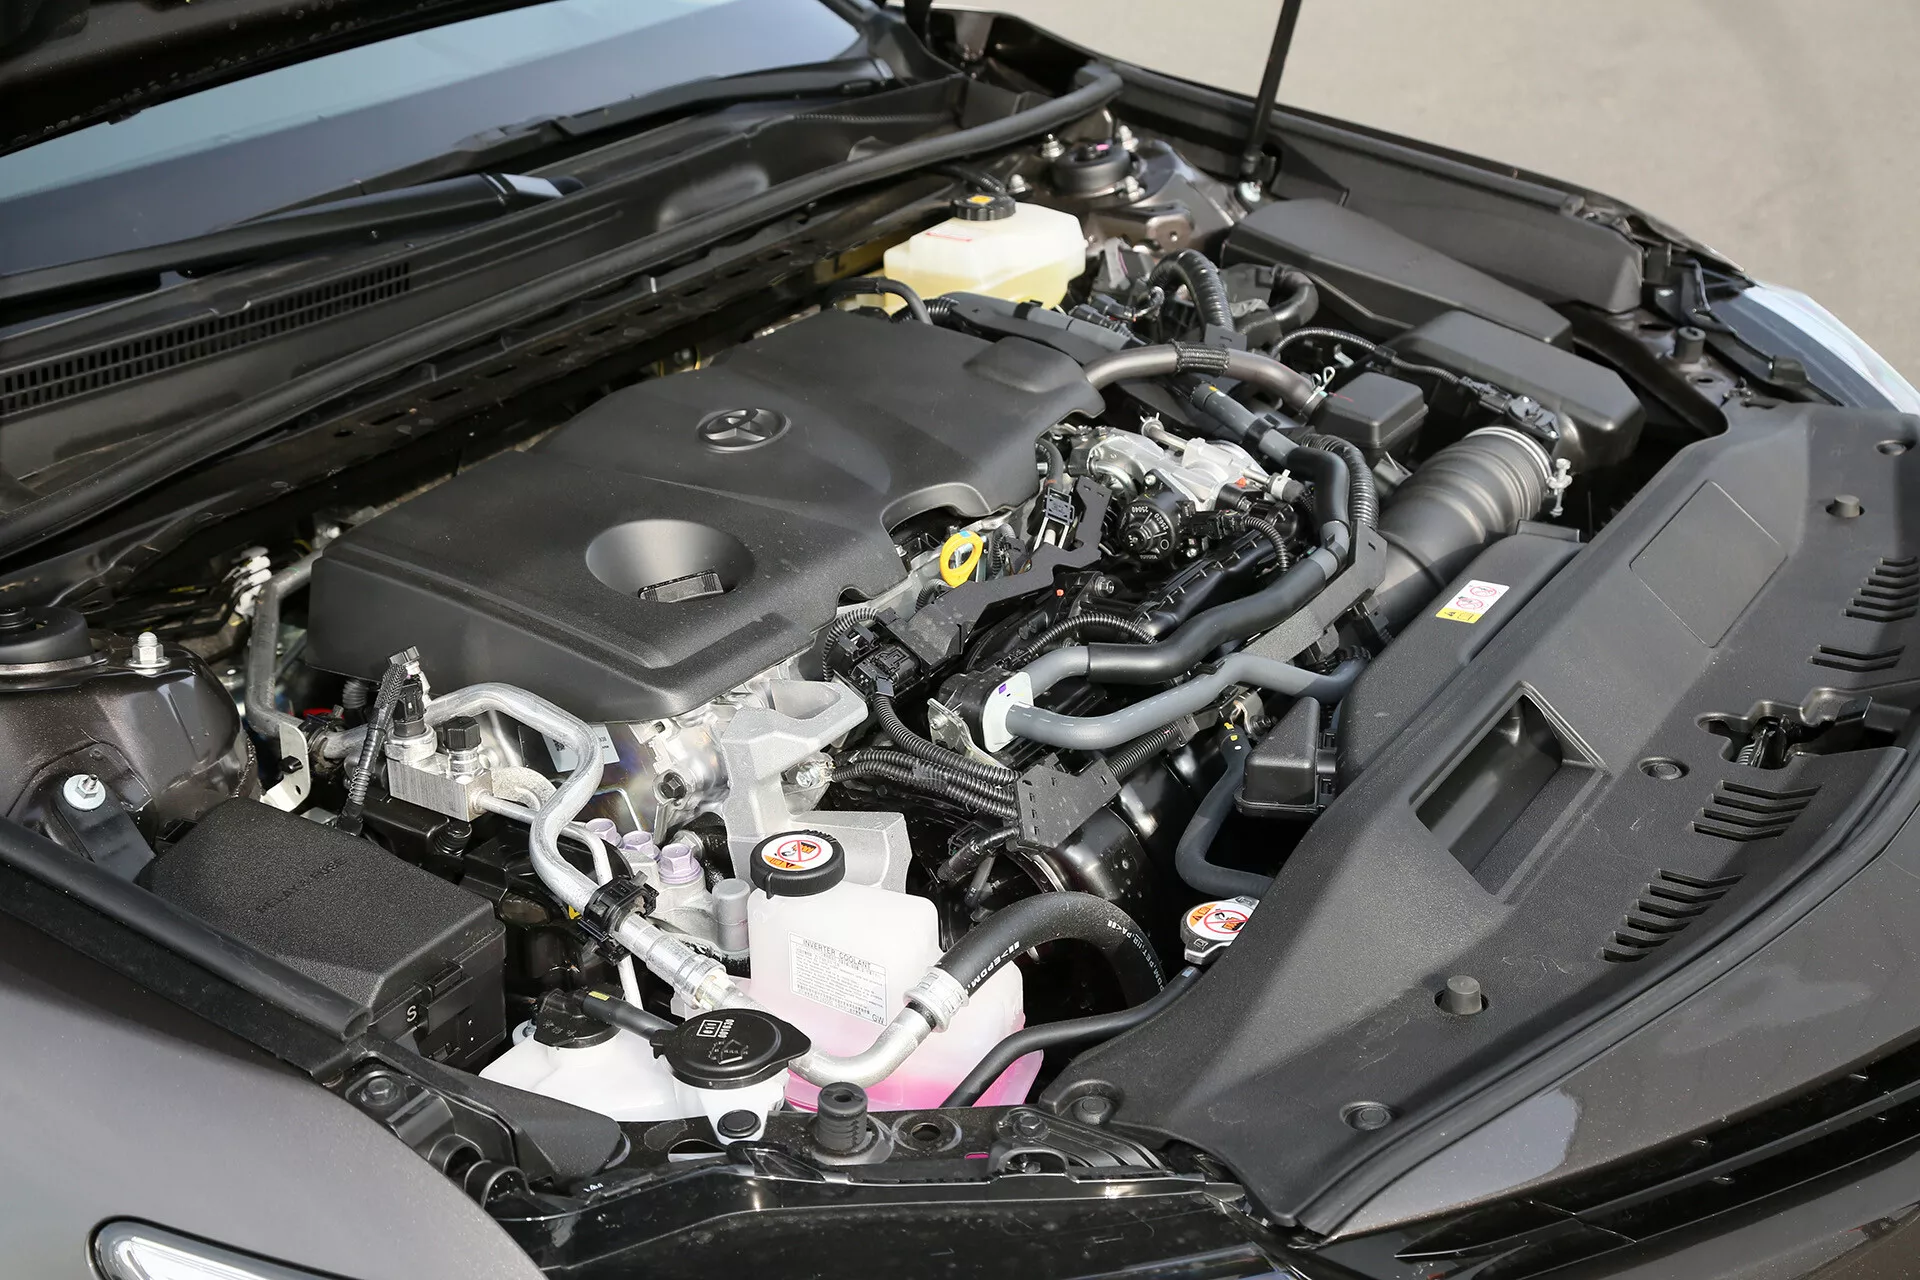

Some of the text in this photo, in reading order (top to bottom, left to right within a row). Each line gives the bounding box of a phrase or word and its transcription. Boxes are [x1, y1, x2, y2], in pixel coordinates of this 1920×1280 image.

[803, 939, 872, 970] INVERTER COOLANT
[406, 1005, 418, 1022] S
